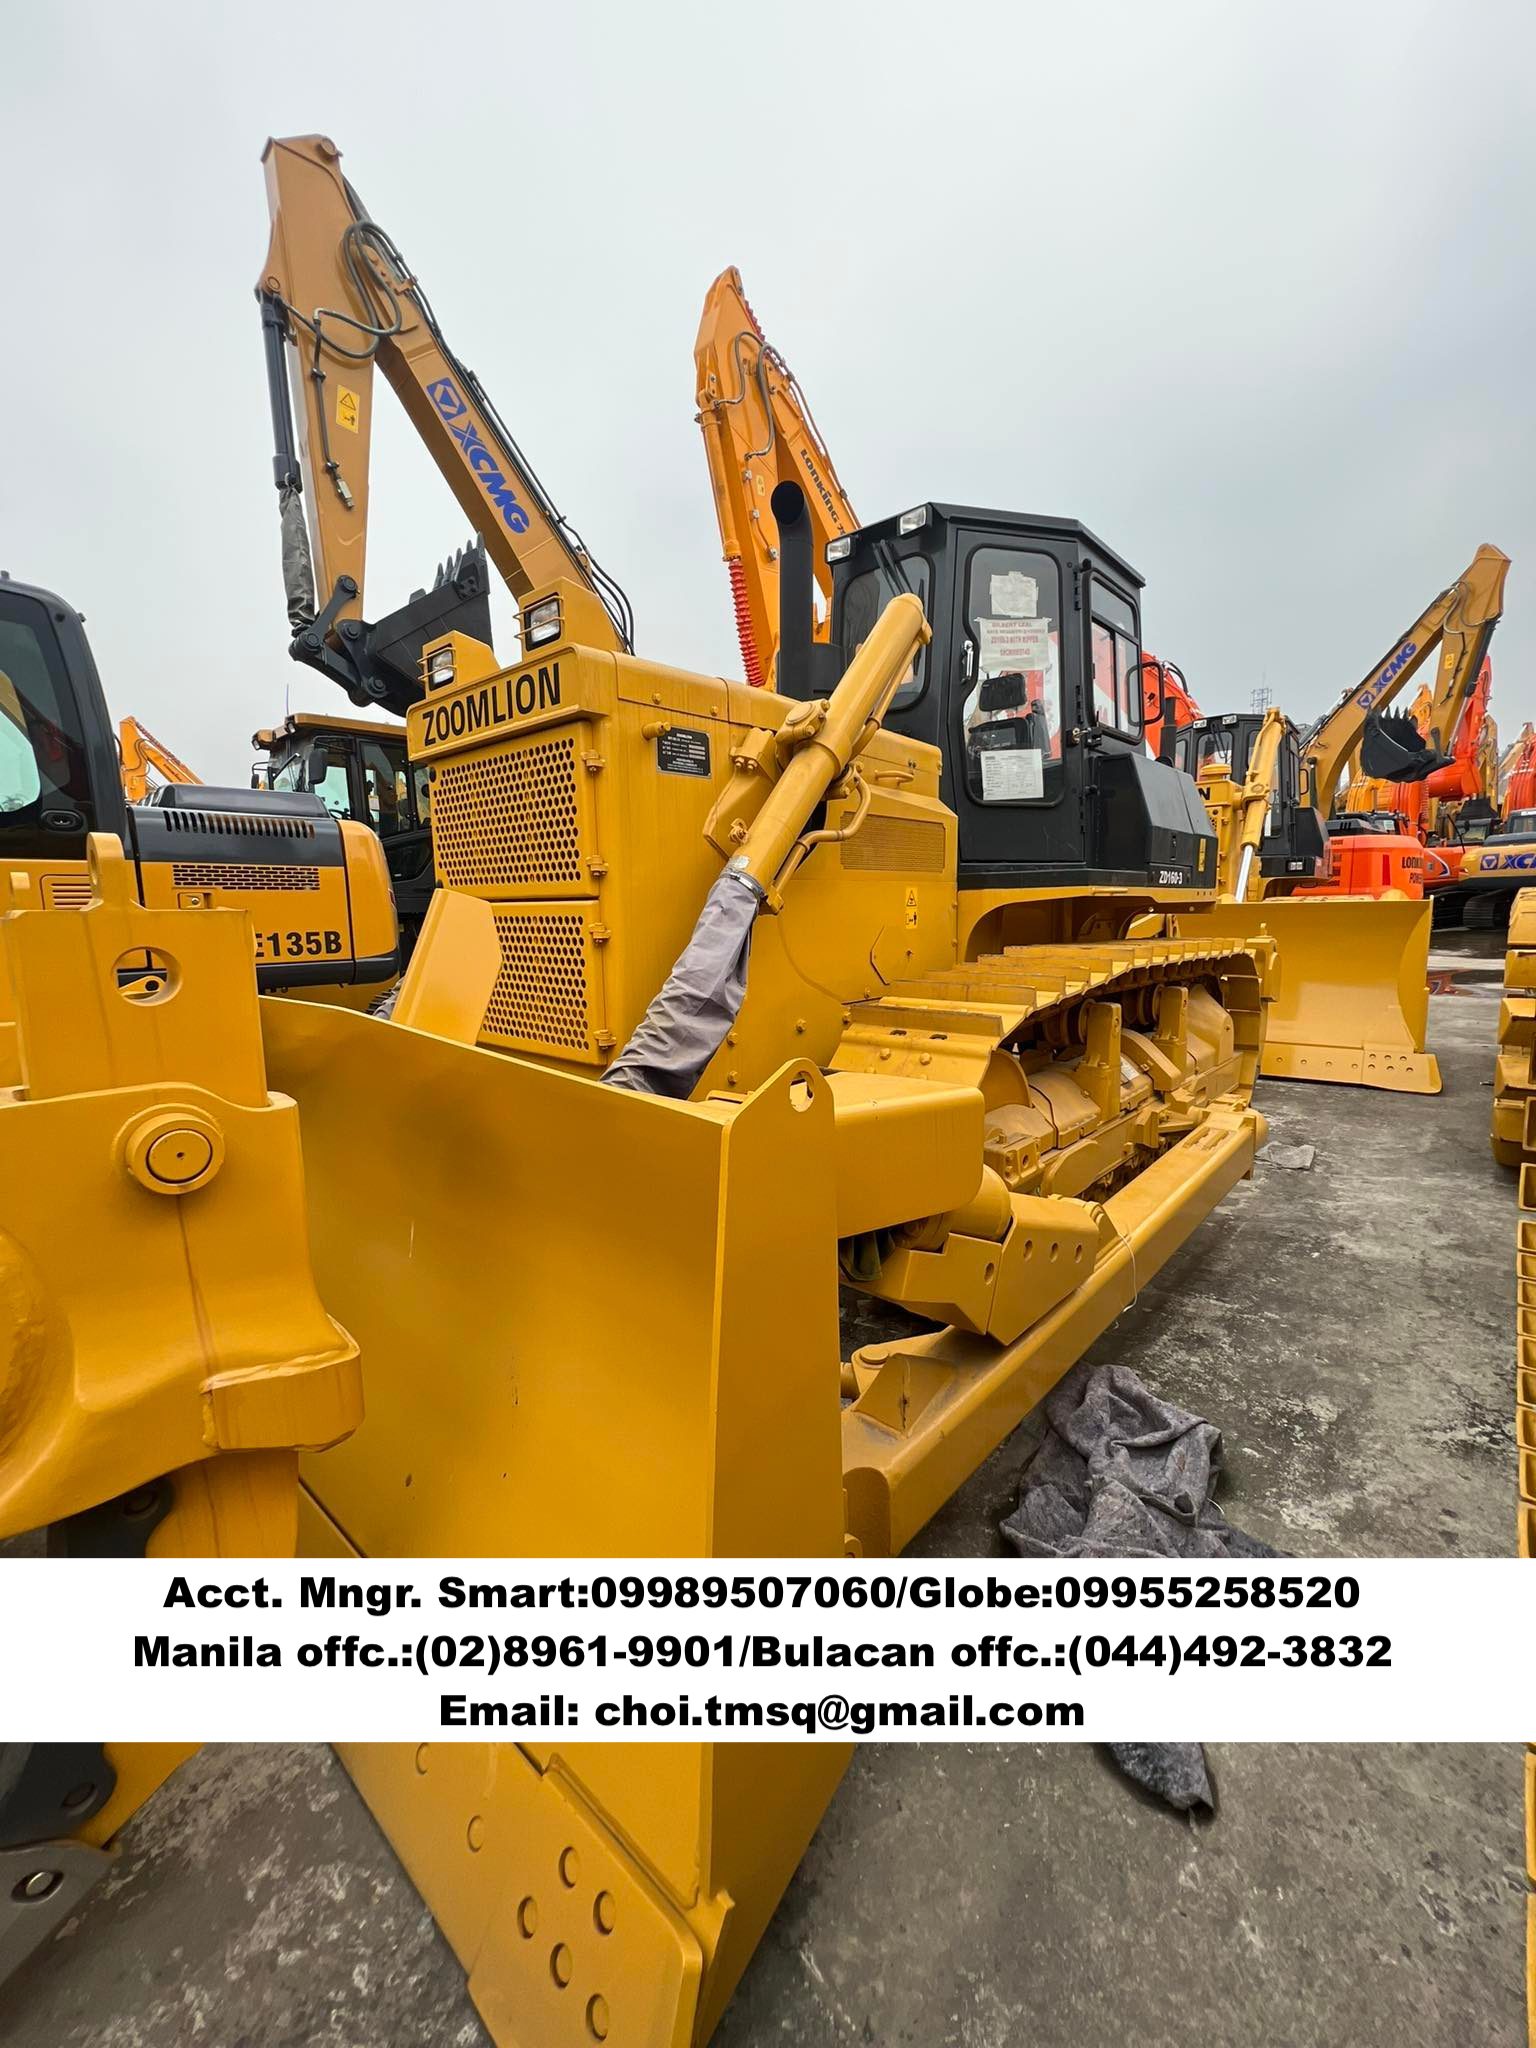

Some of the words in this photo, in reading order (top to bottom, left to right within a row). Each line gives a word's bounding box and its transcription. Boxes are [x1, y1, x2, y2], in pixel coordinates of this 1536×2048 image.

[448, 419, 530, 534] XCMG
[1371, 642, 1416, 695] XCMG
[422, 662, 561, 746] ZOOMLION
[1159, 870, 1183, 885] ZD160-3
